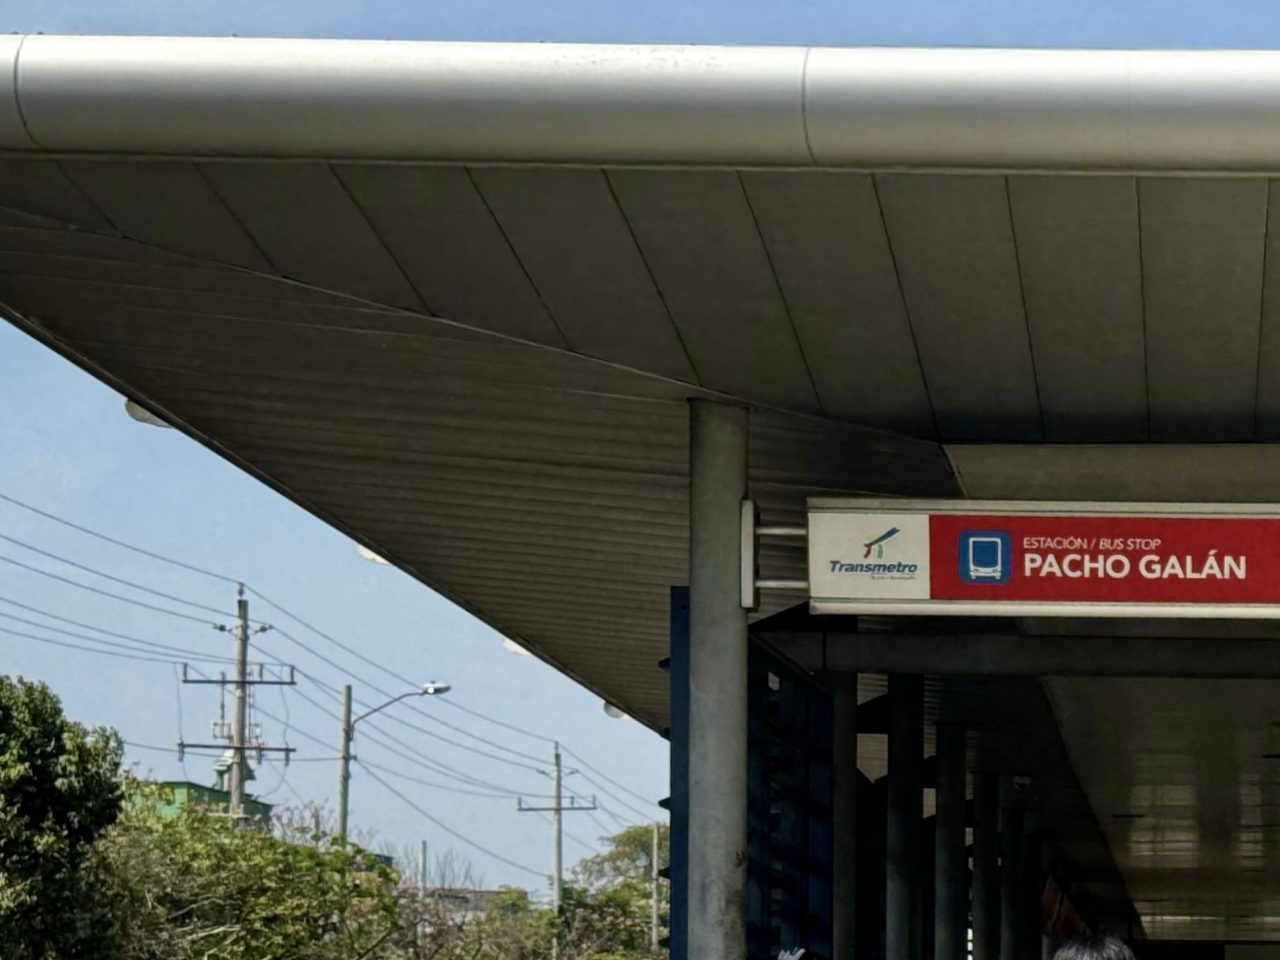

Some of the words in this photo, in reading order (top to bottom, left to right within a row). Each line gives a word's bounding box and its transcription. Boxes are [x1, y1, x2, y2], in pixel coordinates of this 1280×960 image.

[1023, 536, 1088, 549] ESTACIÓN
[1099, 538, 1124, 550] BUS
[1126, 538, 1162, 551] STOP
[830, 560, 918, 573] Transmetro
[1024, 553, 1131, 578] PACHO
[1138, 550, 1247, 579] GALÁN
